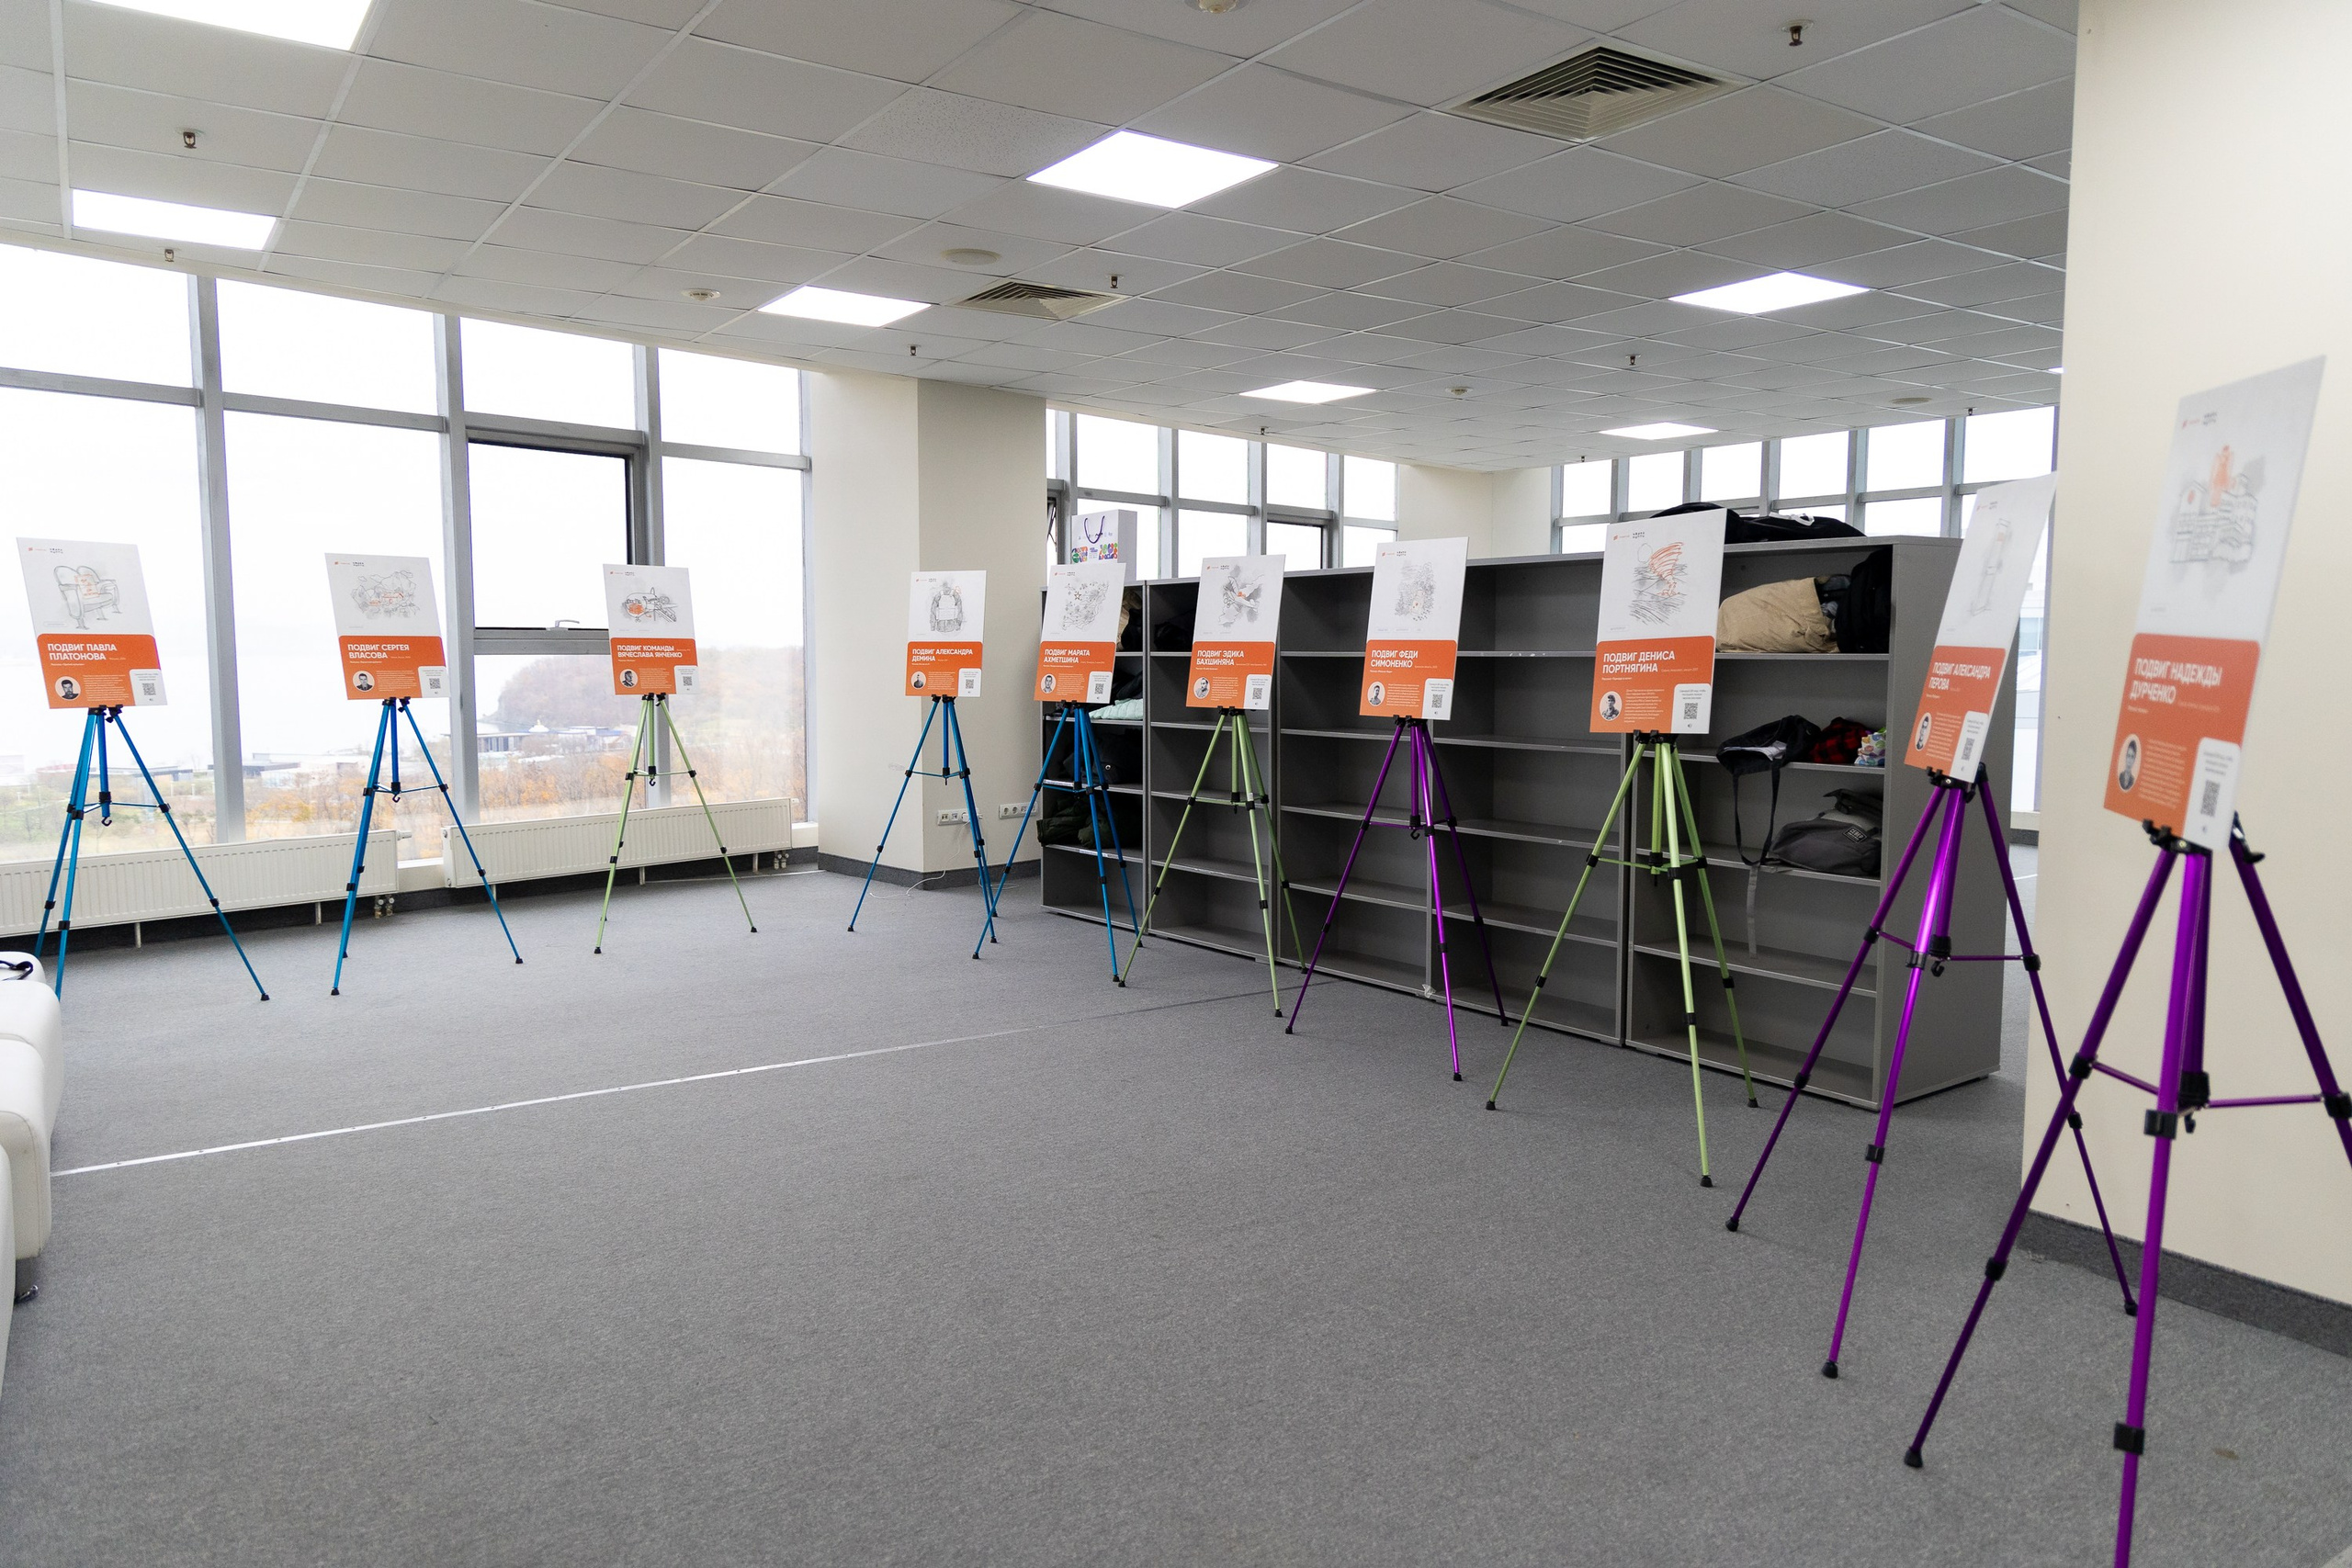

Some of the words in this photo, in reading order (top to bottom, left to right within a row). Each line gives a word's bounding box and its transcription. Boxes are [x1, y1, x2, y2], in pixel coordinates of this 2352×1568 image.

[47, 643, 85, 652] ПОДВИГ
[85, 643, 118, 651] ПАВЛА
[49, 652, 107, 660] ПЛАТОНОВА
[1197, 649, 1222, 658] ПОДВИГ
[1222, 649, 1244, 658] ЭДИКА
[1371, 649, 1397, 659] ПОДВИГ
[1398, 650, 1419, 660] ФЕДИ
[1603, 652, 1637, 663] ПОДВИГ
[1638, 650, 1676, 663] ДЕНИСА
[1196, 658, 1235, 666] БАХШИНЯНА
[1370, 659, 1413, 668] СИМОНЕНКО
[1602, 662, 1658, 674] ПОРТНЯГИНА
[1932, 661, 1955, 677] ПОДВИГ
[1952, 663, 1991, 680] АЛЕКСАНДРА
[2134, 657, 2171, 680] ПОДВИГ
[2170, 661, 2222, 689] НАДЕЖДЫ
[1928, 676, 1950, 691] ПЕРОВА
[2130, 680, 2177, 705] ДУРЧЕНКО
